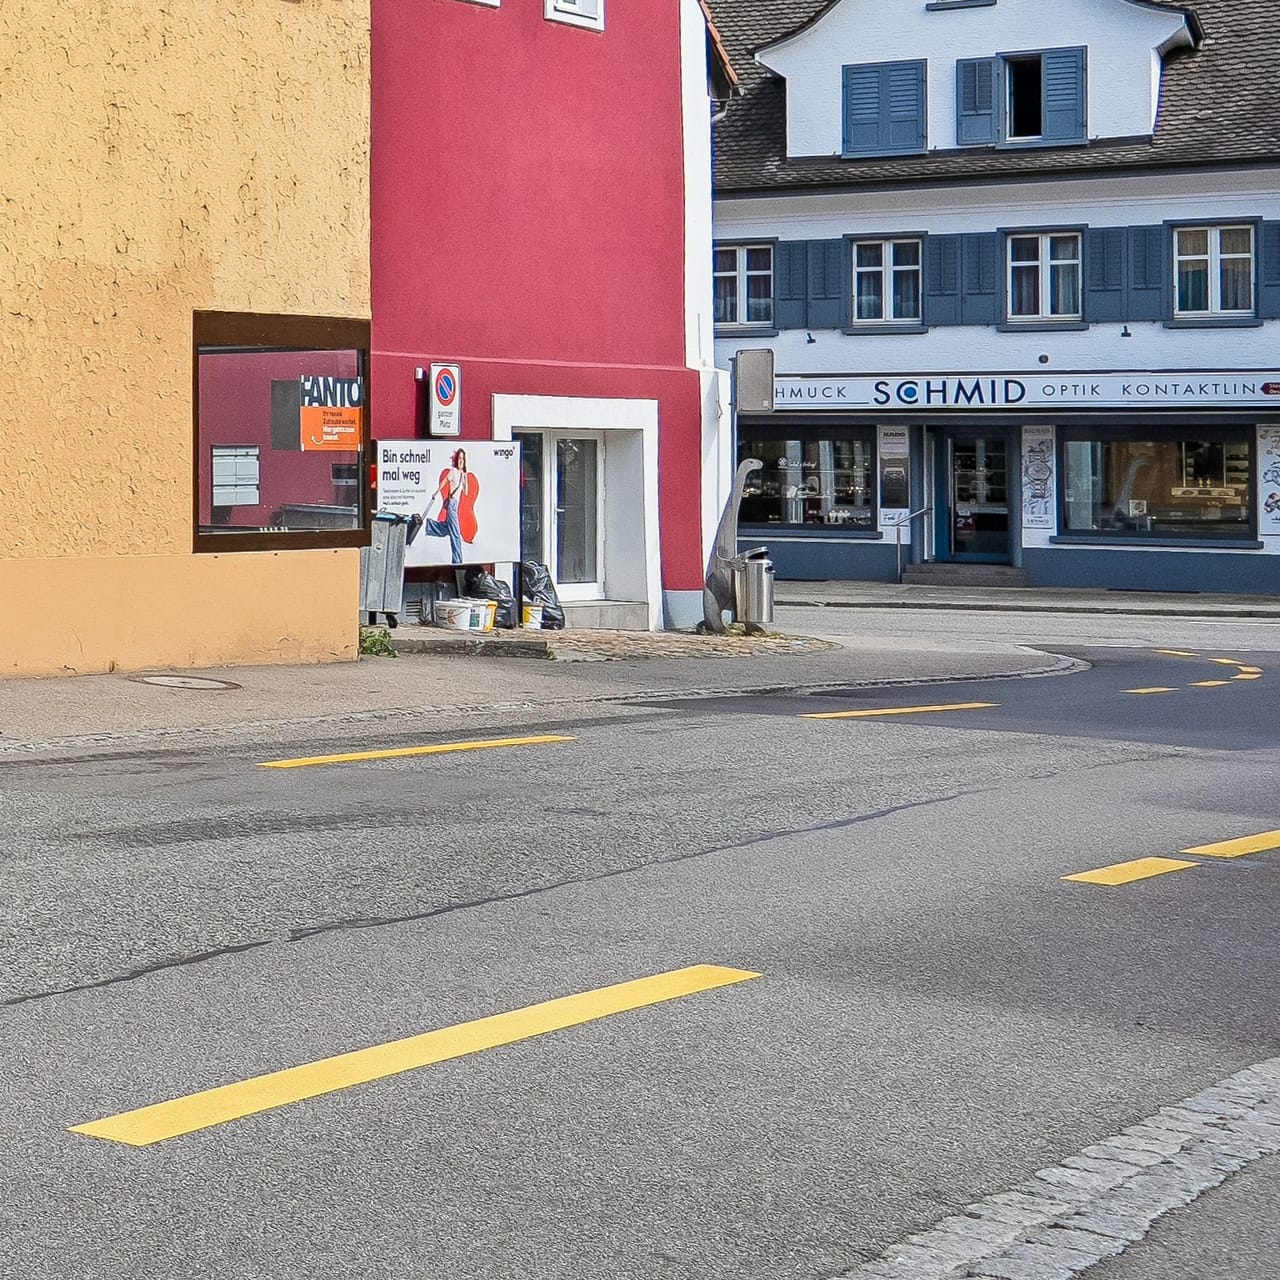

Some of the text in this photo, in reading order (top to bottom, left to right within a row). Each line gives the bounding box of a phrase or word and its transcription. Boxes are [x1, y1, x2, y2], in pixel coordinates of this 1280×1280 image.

[301, 376, 362, 408] FANTO
[873, 378, 1027, 405] SCHMID
[1042, 384, 1101, 397] OPTIK
[382, 449, 431, 463] Bin schnell
[493, 447, 514, 459] wingo
[382, 467, 420, 485] mal weg
